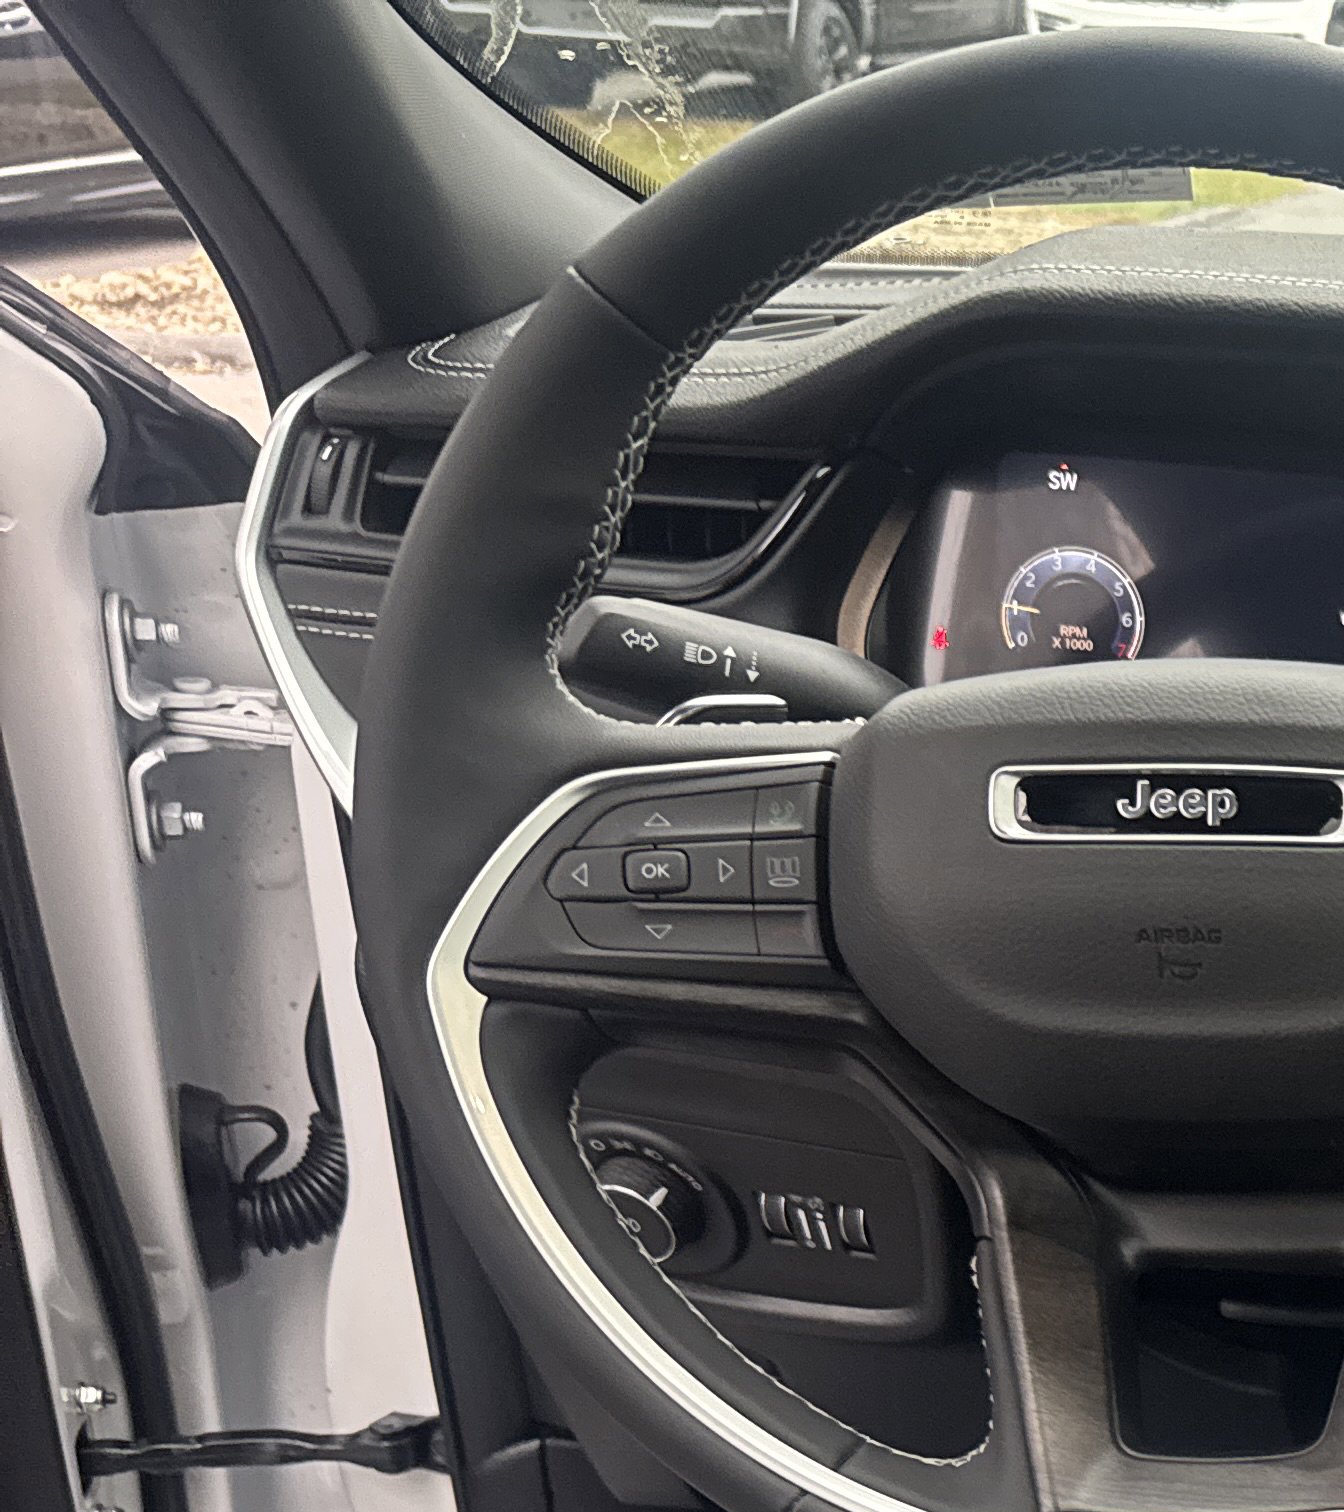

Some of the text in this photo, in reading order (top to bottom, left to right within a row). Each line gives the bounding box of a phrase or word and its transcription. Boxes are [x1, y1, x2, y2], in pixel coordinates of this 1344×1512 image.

[1047, 471, 1078, 491] SW
[1052, 557, 1062, 571] 3
[1086, 558, 1097, 573] 4
[1025, 573, 1036, 588] 2
[1113, 583, 1124, 597] 5
[1121, 612, 1133, 627] 6
[1059, 624, 1088, 638] RPM
[1016, 633, 1029, 647] 0
[1052, 637, 1094, 651] X 1000
[1117, 643, 1128, 657] 7
[1115, 779, 1239, 827] Jeep
[641, 863, 670, 879] OK
[1135, 927, 1222, 945] AIRBAG
